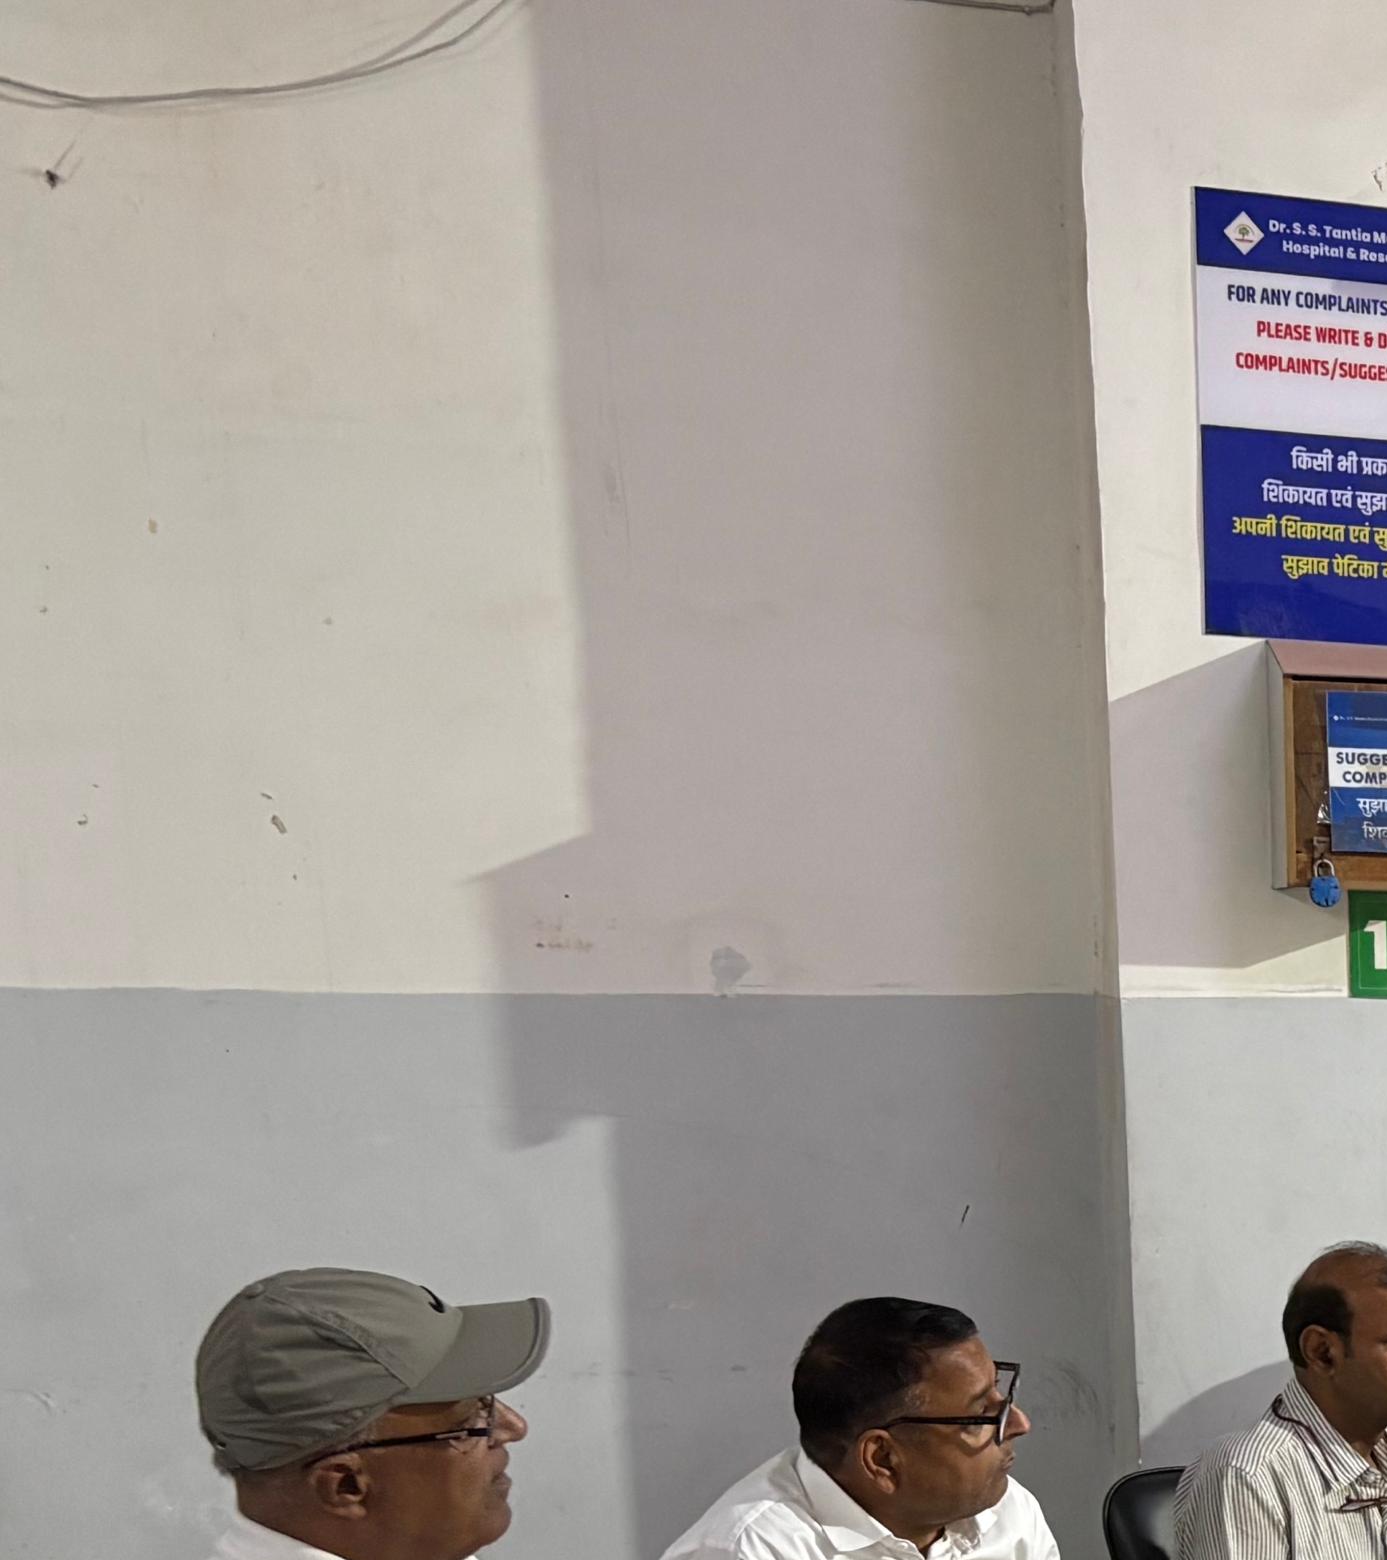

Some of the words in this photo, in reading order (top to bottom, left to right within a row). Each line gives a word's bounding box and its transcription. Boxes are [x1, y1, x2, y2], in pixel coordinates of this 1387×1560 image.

[1269, 219, 1290, 234] Dr.
[1292, 221, 1306, 235] S.
[1308, 224, 1321, 237] S.
[1323, 225, 1371, 244] Tantia
[1282, 240, 1344, 260] Hospital
[1346, 246, 1357, 259] &
[1228, 284, 1255, 304] FOR
[1260, 288, 1291, 306] ANY
[1257, 320, 1311, 342] PLEASE
[1316, 326, 1359, 347] WRITE
[1364, 332, 1373, 347] &
[1291, 447, 1333, 472] किसी
[1337, 451, 1357, 474] भी
[1262, 479, 1328, 506] शिकायत
[1331, 487, 1352, 508] एवं
[1232, 515, 1277, 537] अपनी
[1281, 516, 1345, 542] शिकायत
[1349, 522, 1370, 543] एवं
[1282, 554, 1328, 579] सुझाव
[1332, 555, 1378, 579] पेटिका
